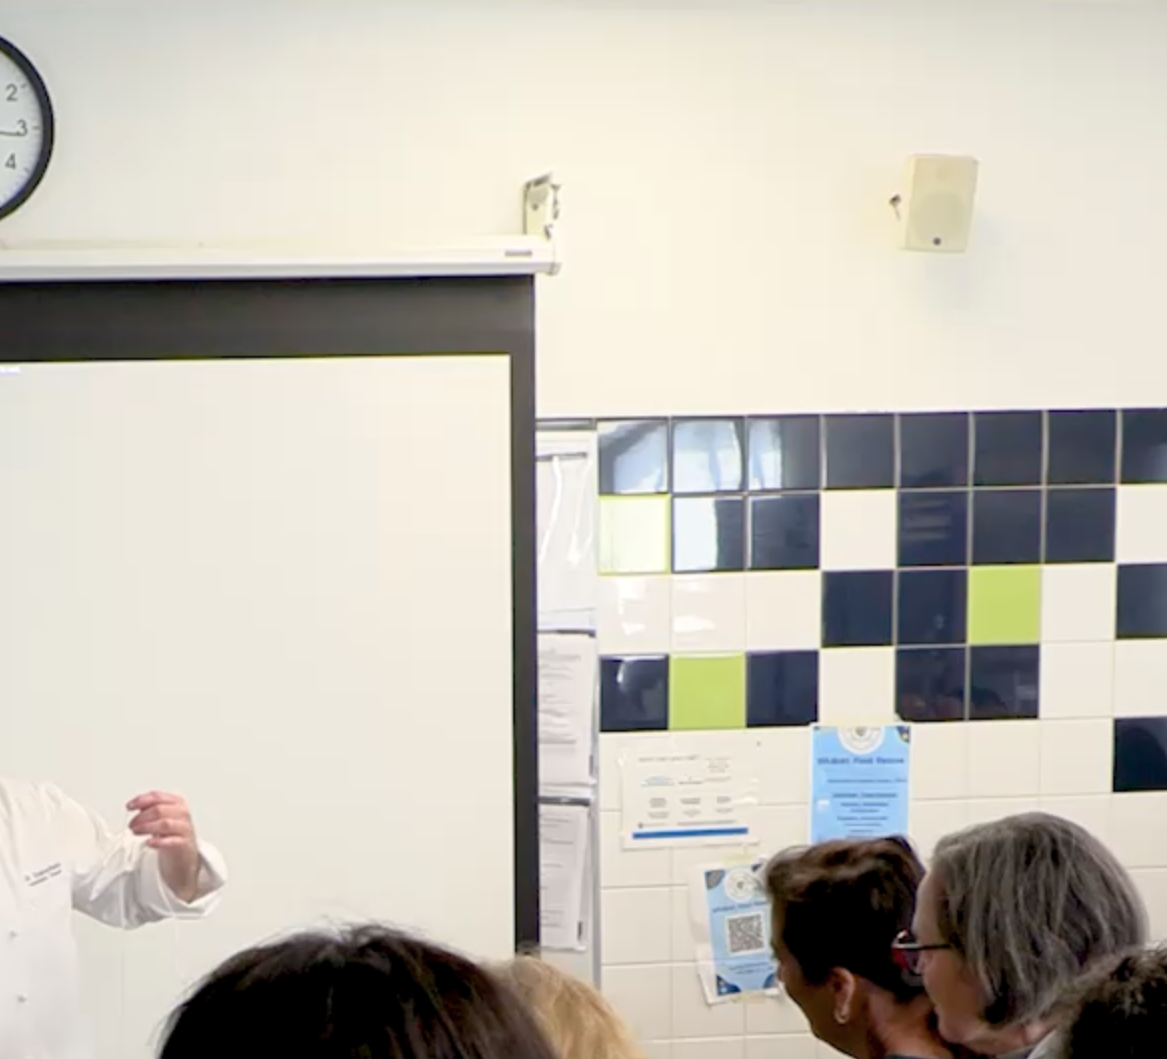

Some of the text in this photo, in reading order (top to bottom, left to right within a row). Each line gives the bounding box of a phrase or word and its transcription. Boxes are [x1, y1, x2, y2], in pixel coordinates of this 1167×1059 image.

[6, 84, 18, 102] 2
[16, 120, 28, 137] 3
[4, 153, 17, 170] 4
